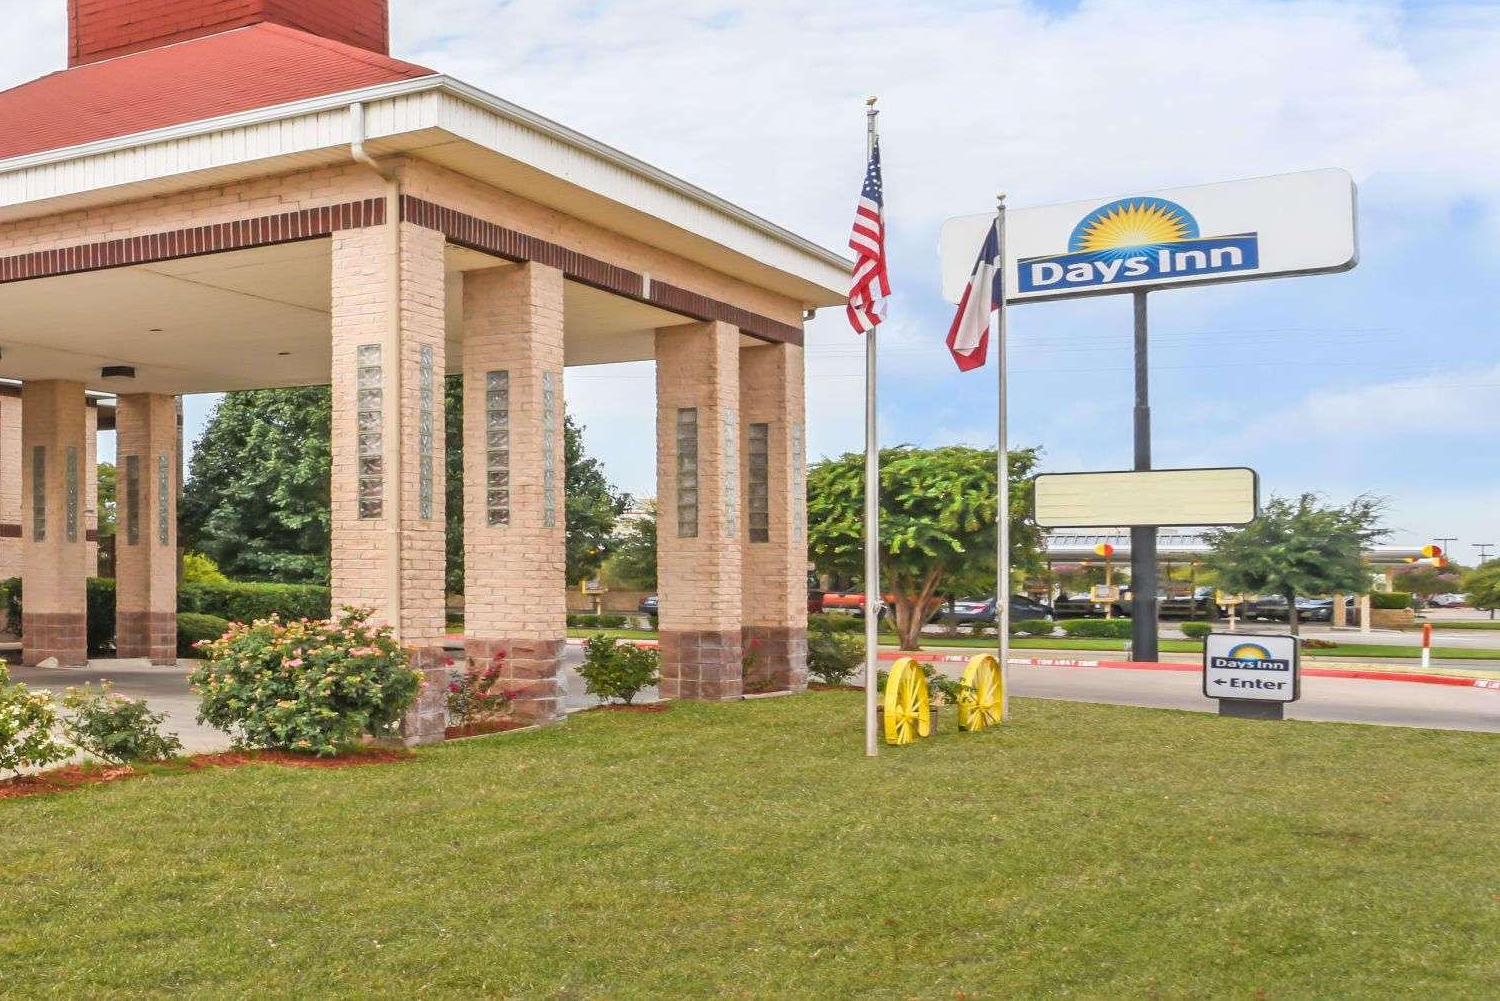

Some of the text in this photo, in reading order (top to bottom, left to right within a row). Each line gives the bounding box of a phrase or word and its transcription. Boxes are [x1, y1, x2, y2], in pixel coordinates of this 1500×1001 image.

[1031, 246, 1243, 286] Days Inn
[1215, 658, 1284, 670] Days Inn
[1230, 677, 1287, 690] Enter
